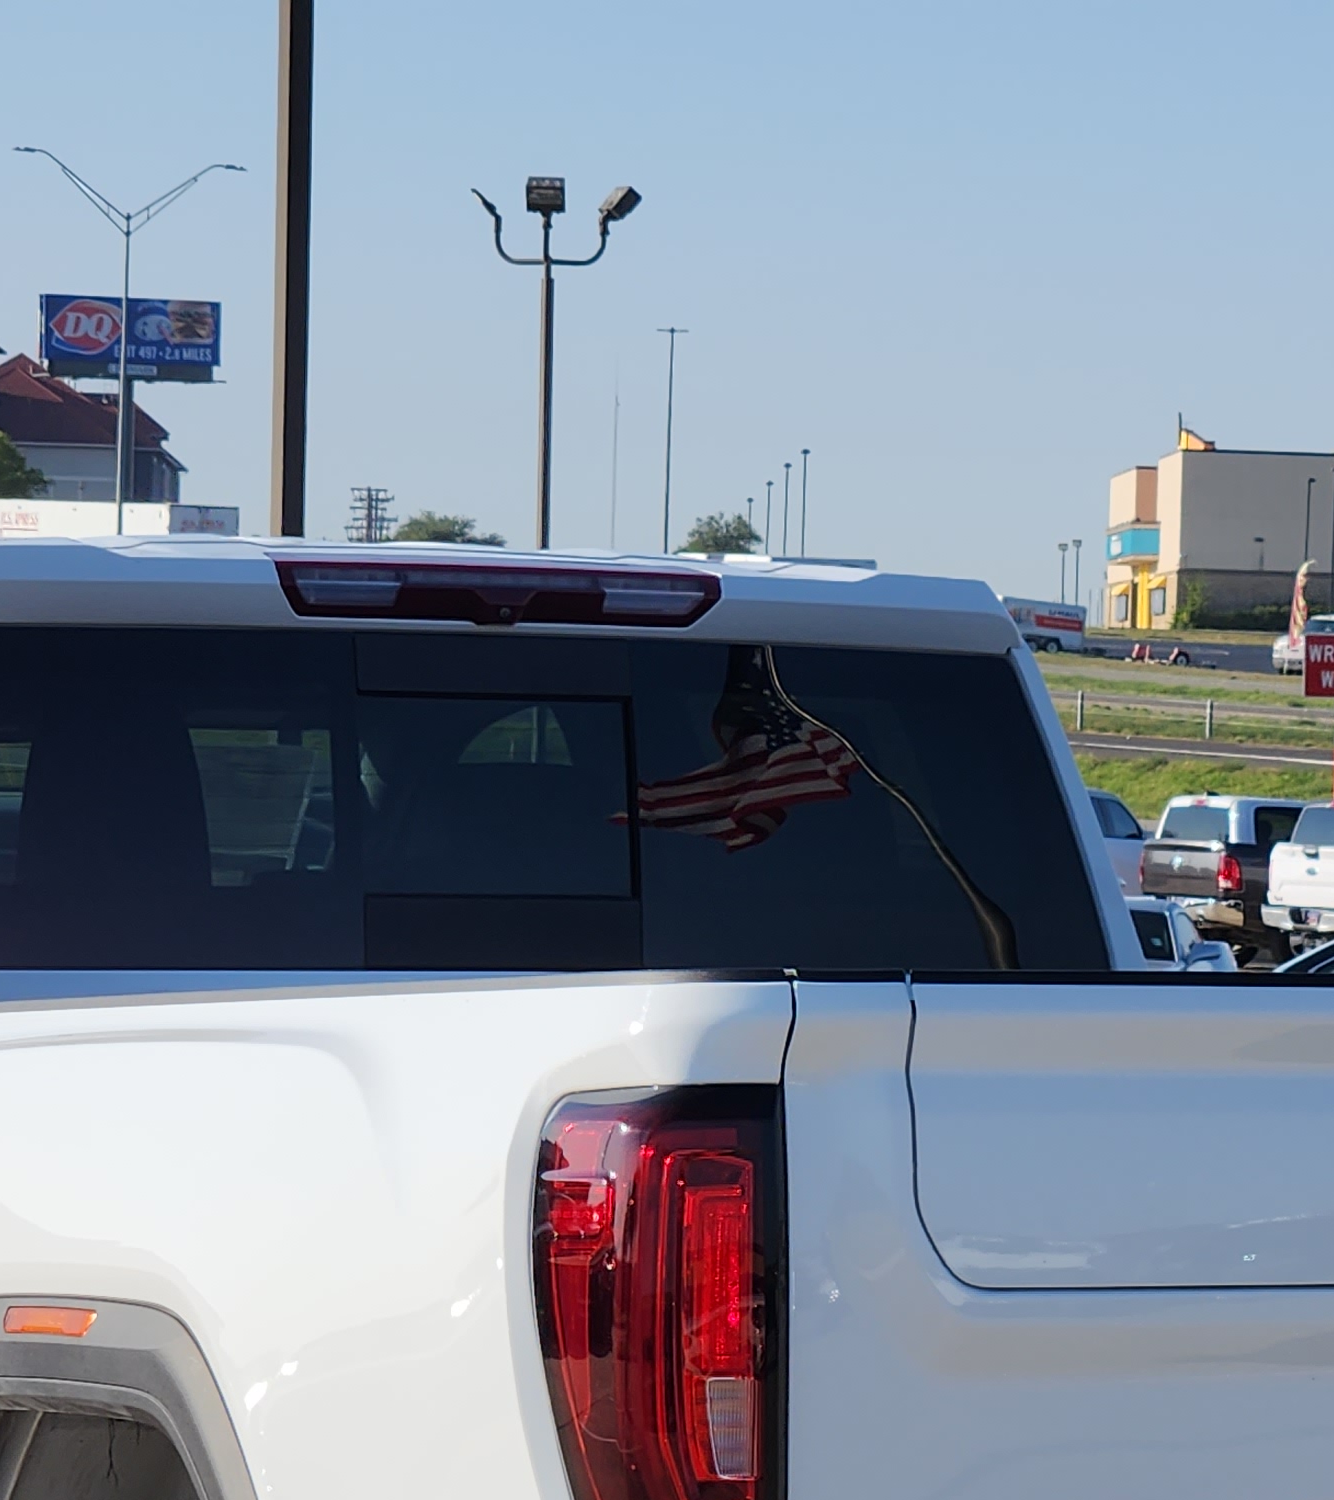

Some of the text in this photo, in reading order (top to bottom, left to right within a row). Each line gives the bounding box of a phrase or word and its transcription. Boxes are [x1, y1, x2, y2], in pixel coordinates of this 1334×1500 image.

[63, 311, 113, 344] DQ
[114, 344, 136, 358] EIT
[138, 345, 157, 359] 497
[182, 348, 212, 362] MILES
